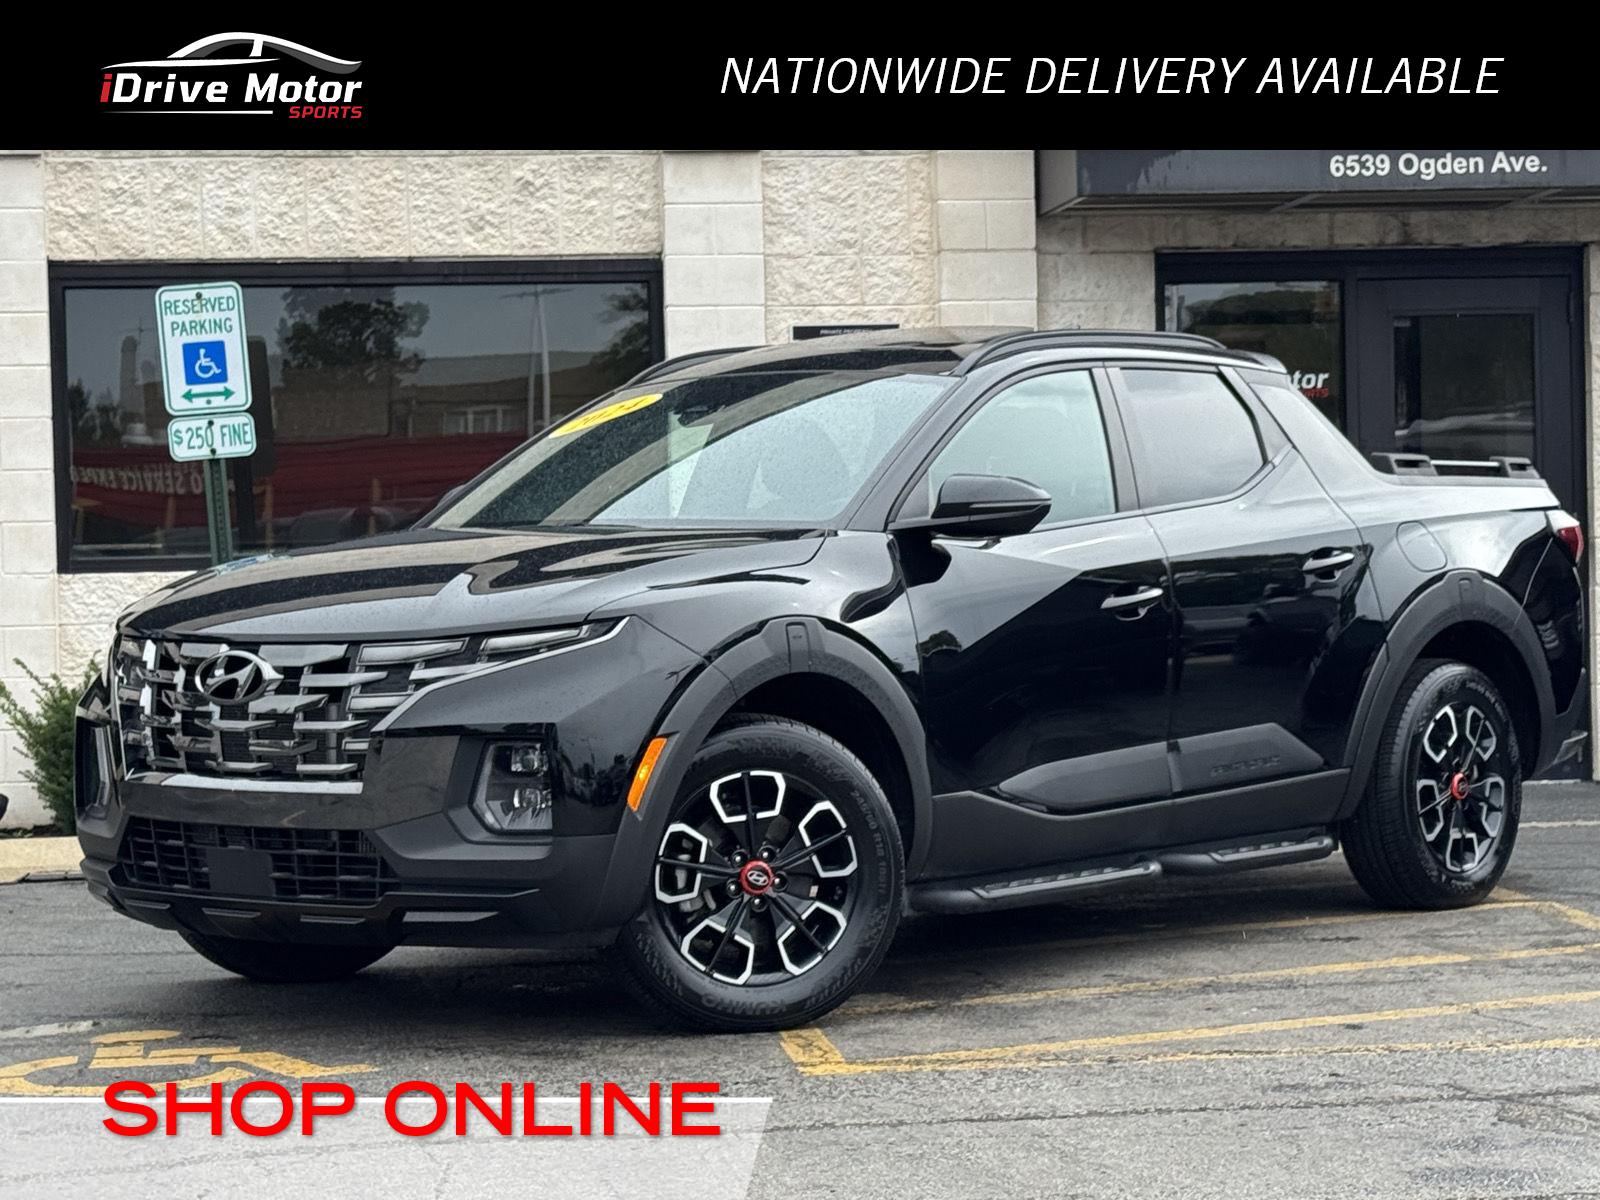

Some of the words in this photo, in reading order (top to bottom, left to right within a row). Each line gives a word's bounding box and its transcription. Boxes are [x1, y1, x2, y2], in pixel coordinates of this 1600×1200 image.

[1329, 154, 1391, 177] 6539
[1398, 153, 1484, 180] Ogden
[1490, 152, 1548, 173] Ave.
[163, 296, 236, 316] RESERVED
[171, 317, 233, 337] PARKING
[1292, 370, 1330, 389] tor
[173, 425, 214, 450] $250
[220, 423, 251, 447] FINE
